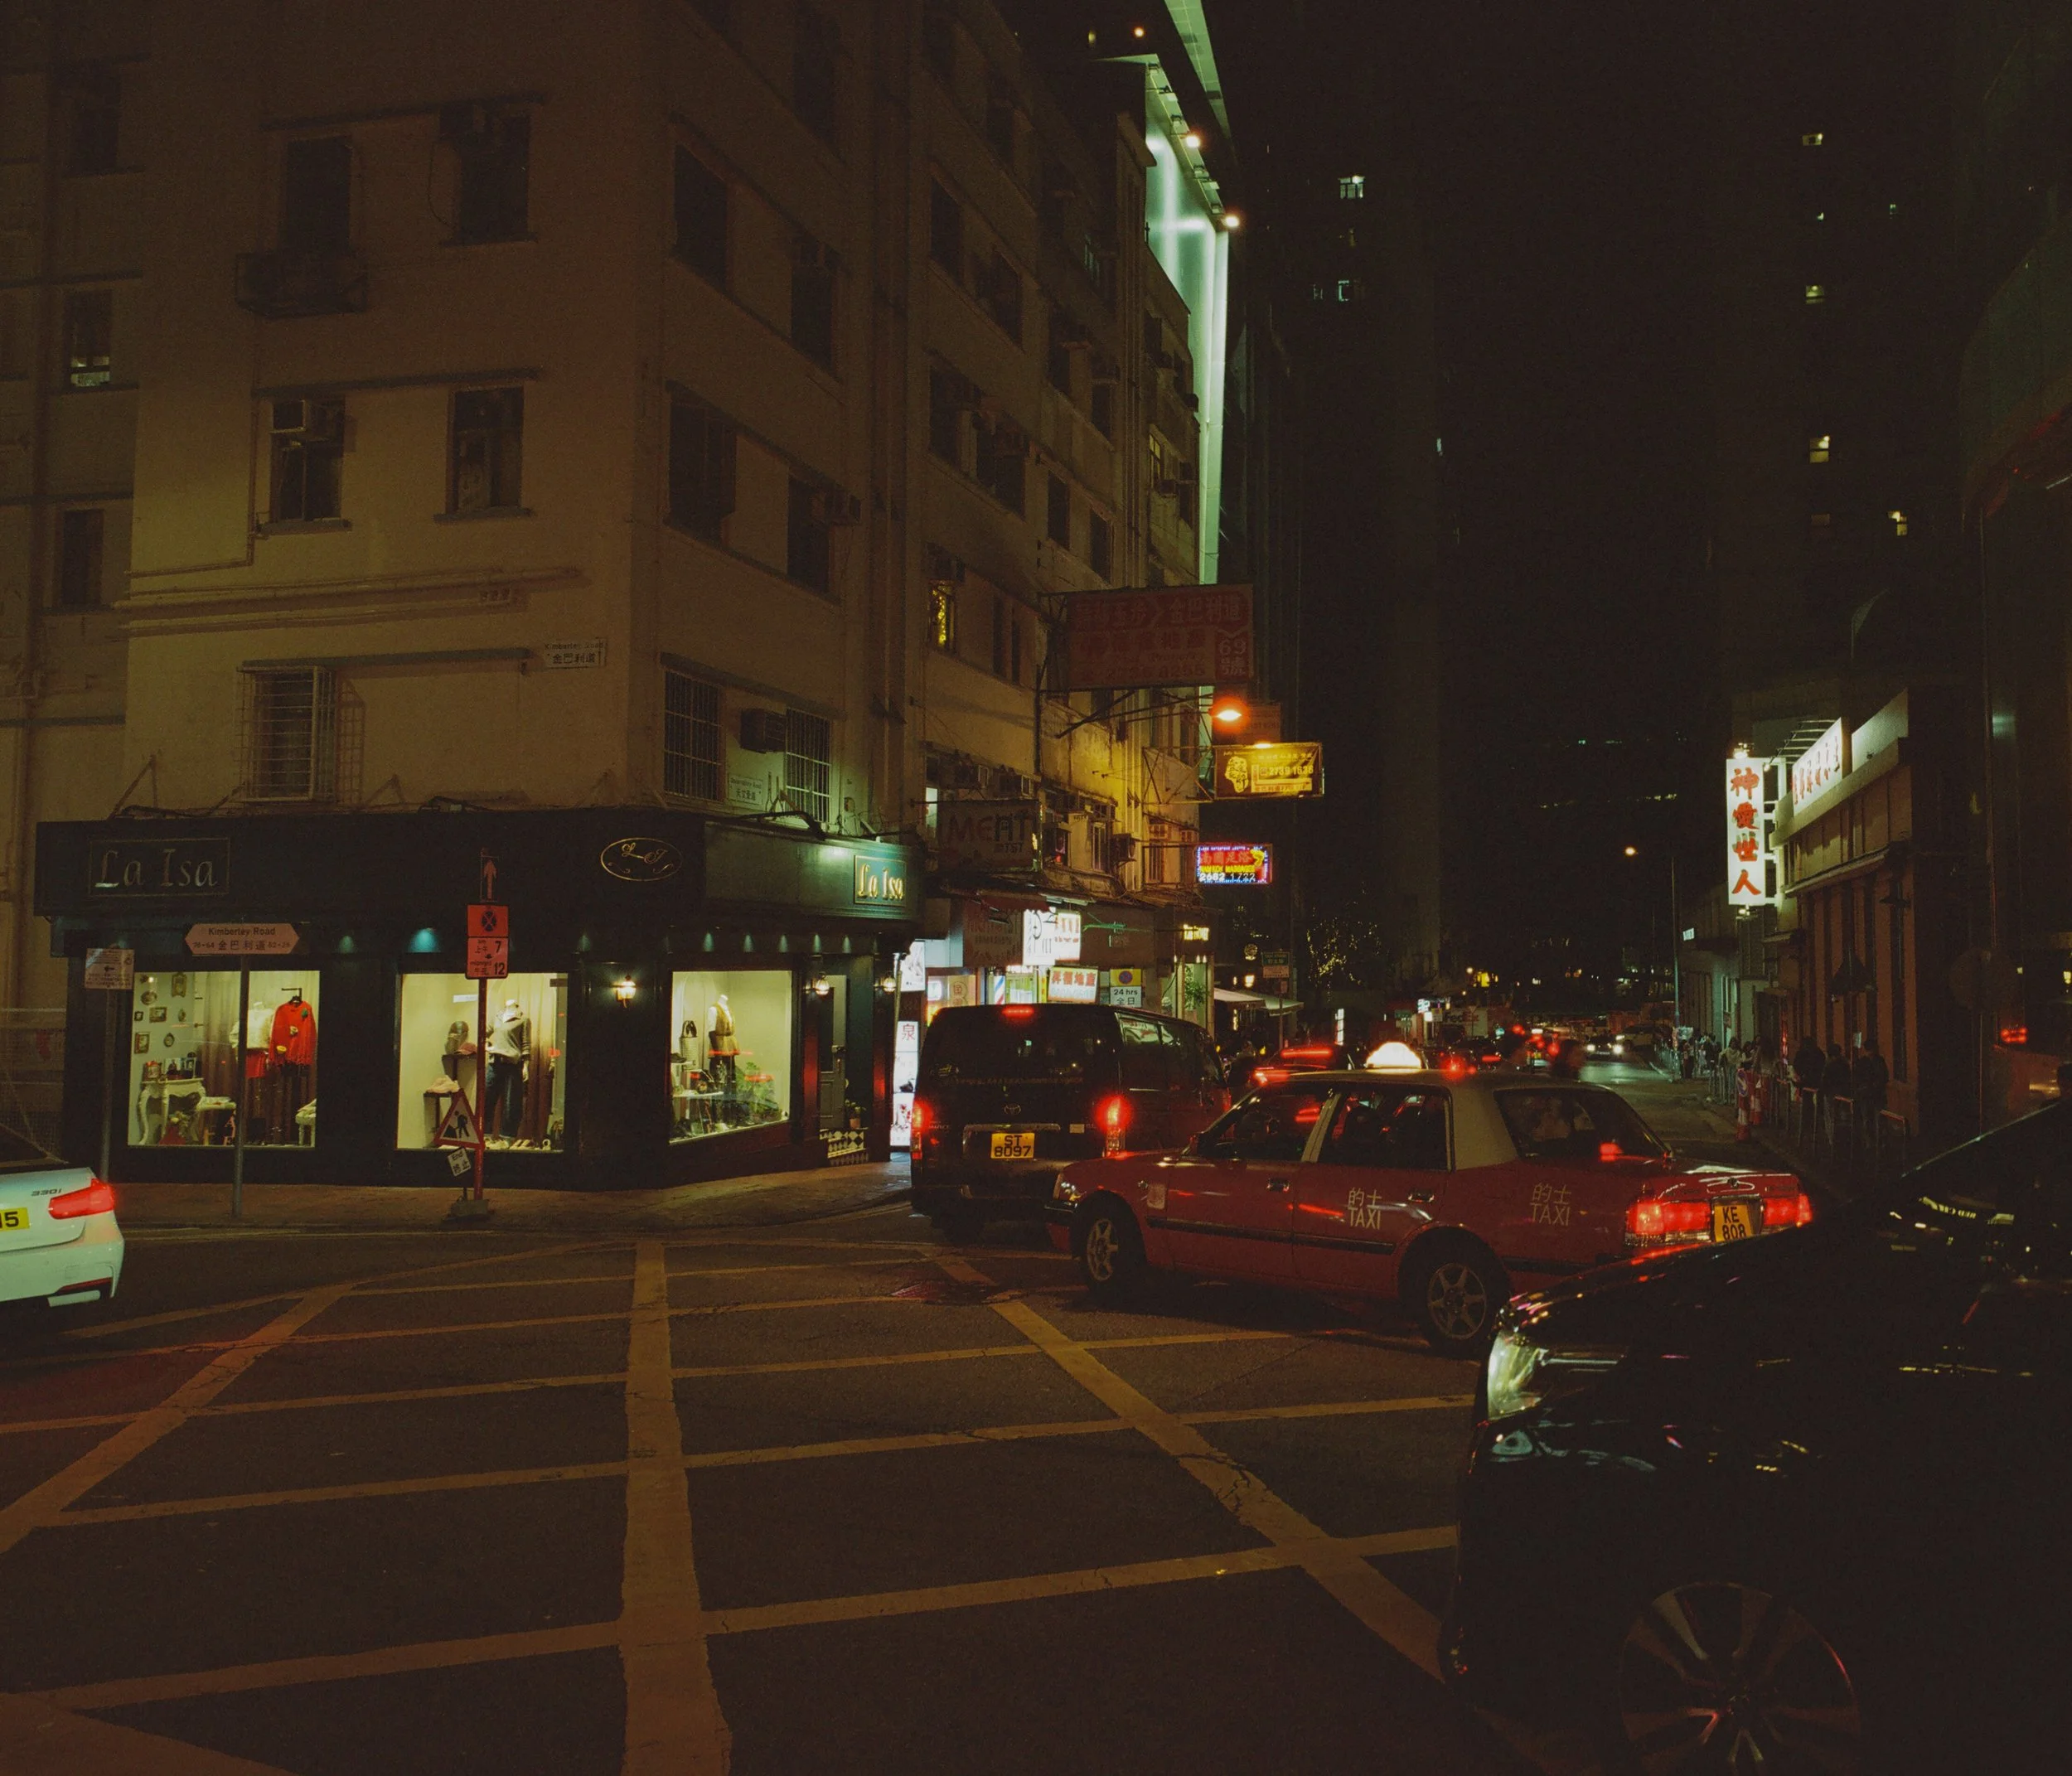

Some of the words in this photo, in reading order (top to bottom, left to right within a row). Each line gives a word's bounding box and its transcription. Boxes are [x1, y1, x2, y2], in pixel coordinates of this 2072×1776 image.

[1169, 597, 1241, 623] 金巴利道
[1218, 639, 1247, 656] 69
[1220, 657, 1246, 675] 號
[1731, 767, 1762, 896] 神愛世人
[94, 849, 146, 888] La
[160, 848, 218, 888] Isa
[858, 863, 878, 898] La
[882, 867, 903, 900] Isa
[1198, 873, 1226, 882] 2682
[208, 927, 250, 937] Kimberley
[253, 927, 276, 936] Road
[218, 940, 266, 951] 金巴利道
[494, 940, 502, 953] 7
[494, 962, 506, 975] 12
[1116, 997, 1135, 1005] 全日
[902, 1023, 915, 1041] 泉
[1005, 1135, 1023, 1146] ST
[995, 1146, 1031, 1157] 8097
[1348, 1187, 1382, 1209] 的士
[1532, 1182, 1571, 1204] 的士
[0, 1211, 20, 1228] 5
[1348, 1207, 1381, 1230] TAXI
[1530, 1203, 1571, 1227] TAXI
[1722, 1206, 1740, 1224] KE
[1722, 1223, 1747, 1241] 808
